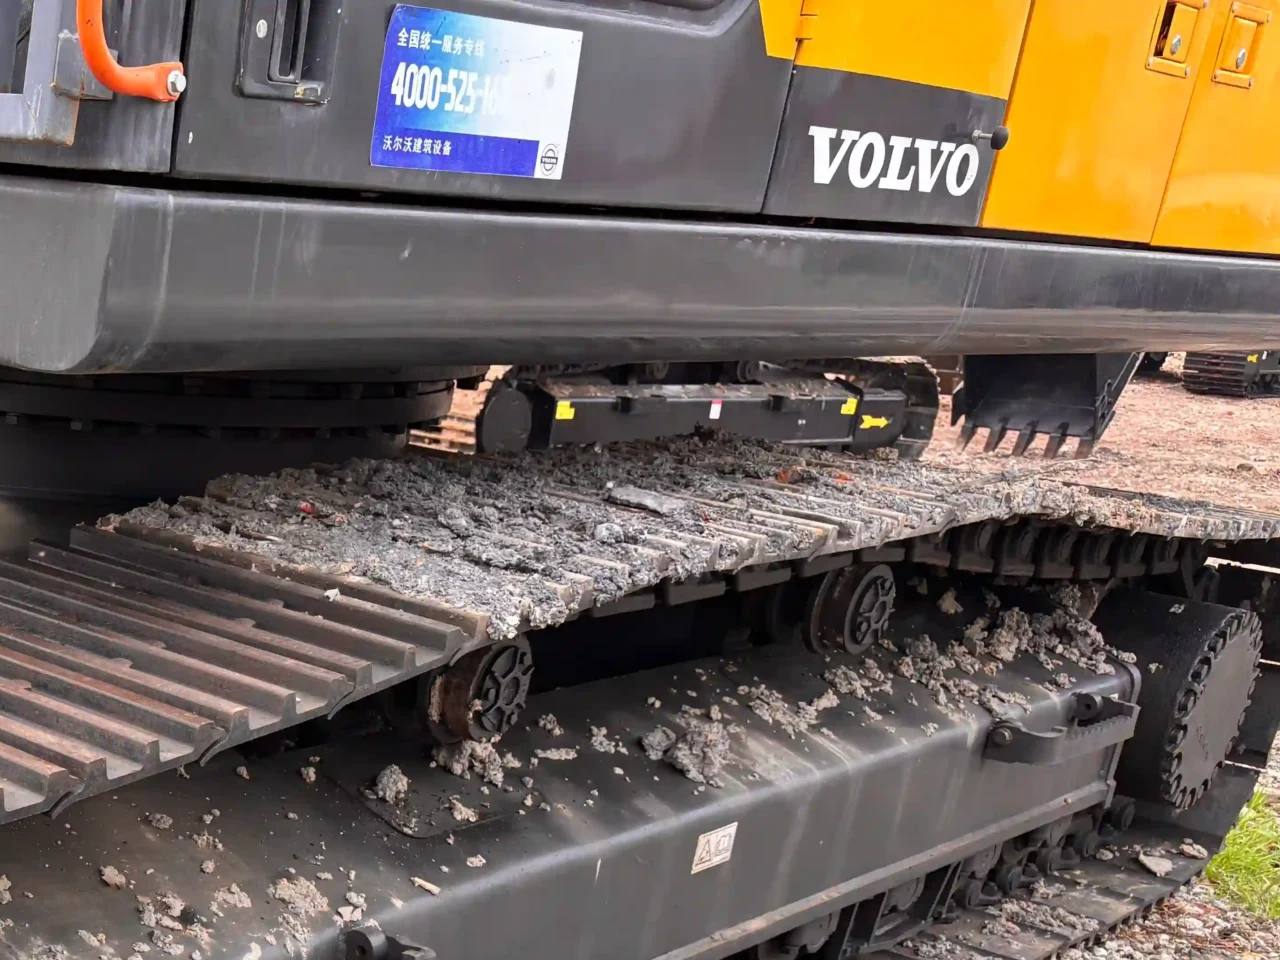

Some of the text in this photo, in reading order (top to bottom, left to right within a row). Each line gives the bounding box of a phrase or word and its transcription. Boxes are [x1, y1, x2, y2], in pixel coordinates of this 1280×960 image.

[397, 28, 485, 56] 全国统一服务专线
[382, 134, 453, 157] 沃尔沃建筑设备
[808, 126, 980, 197] VOLVO
